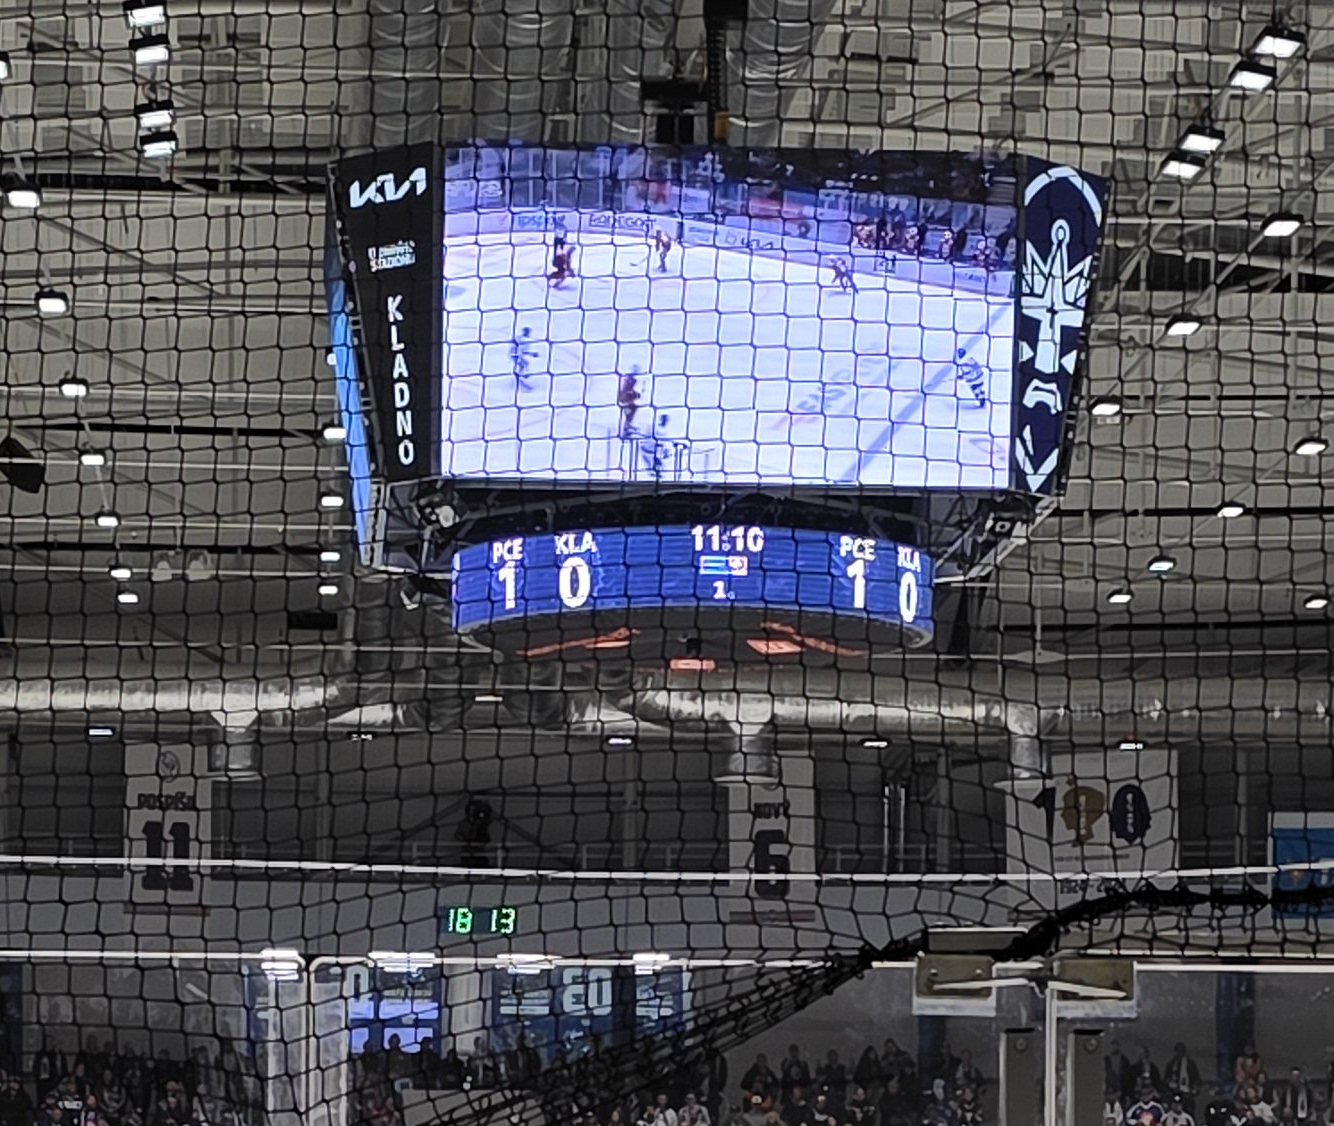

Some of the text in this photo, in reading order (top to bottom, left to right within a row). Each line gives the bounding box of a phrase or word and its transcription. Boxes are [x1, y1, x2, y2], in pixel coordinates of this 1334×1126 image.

[387, 294, 415, 466] KLADNO
[492, 537, 524, 563] PCE
[498, 556, 591, 610] 1 0
[847, 559, 917, 623] 1 0
[141, 821, 194, 892] 11
[754, 830, 791, 898] 6
